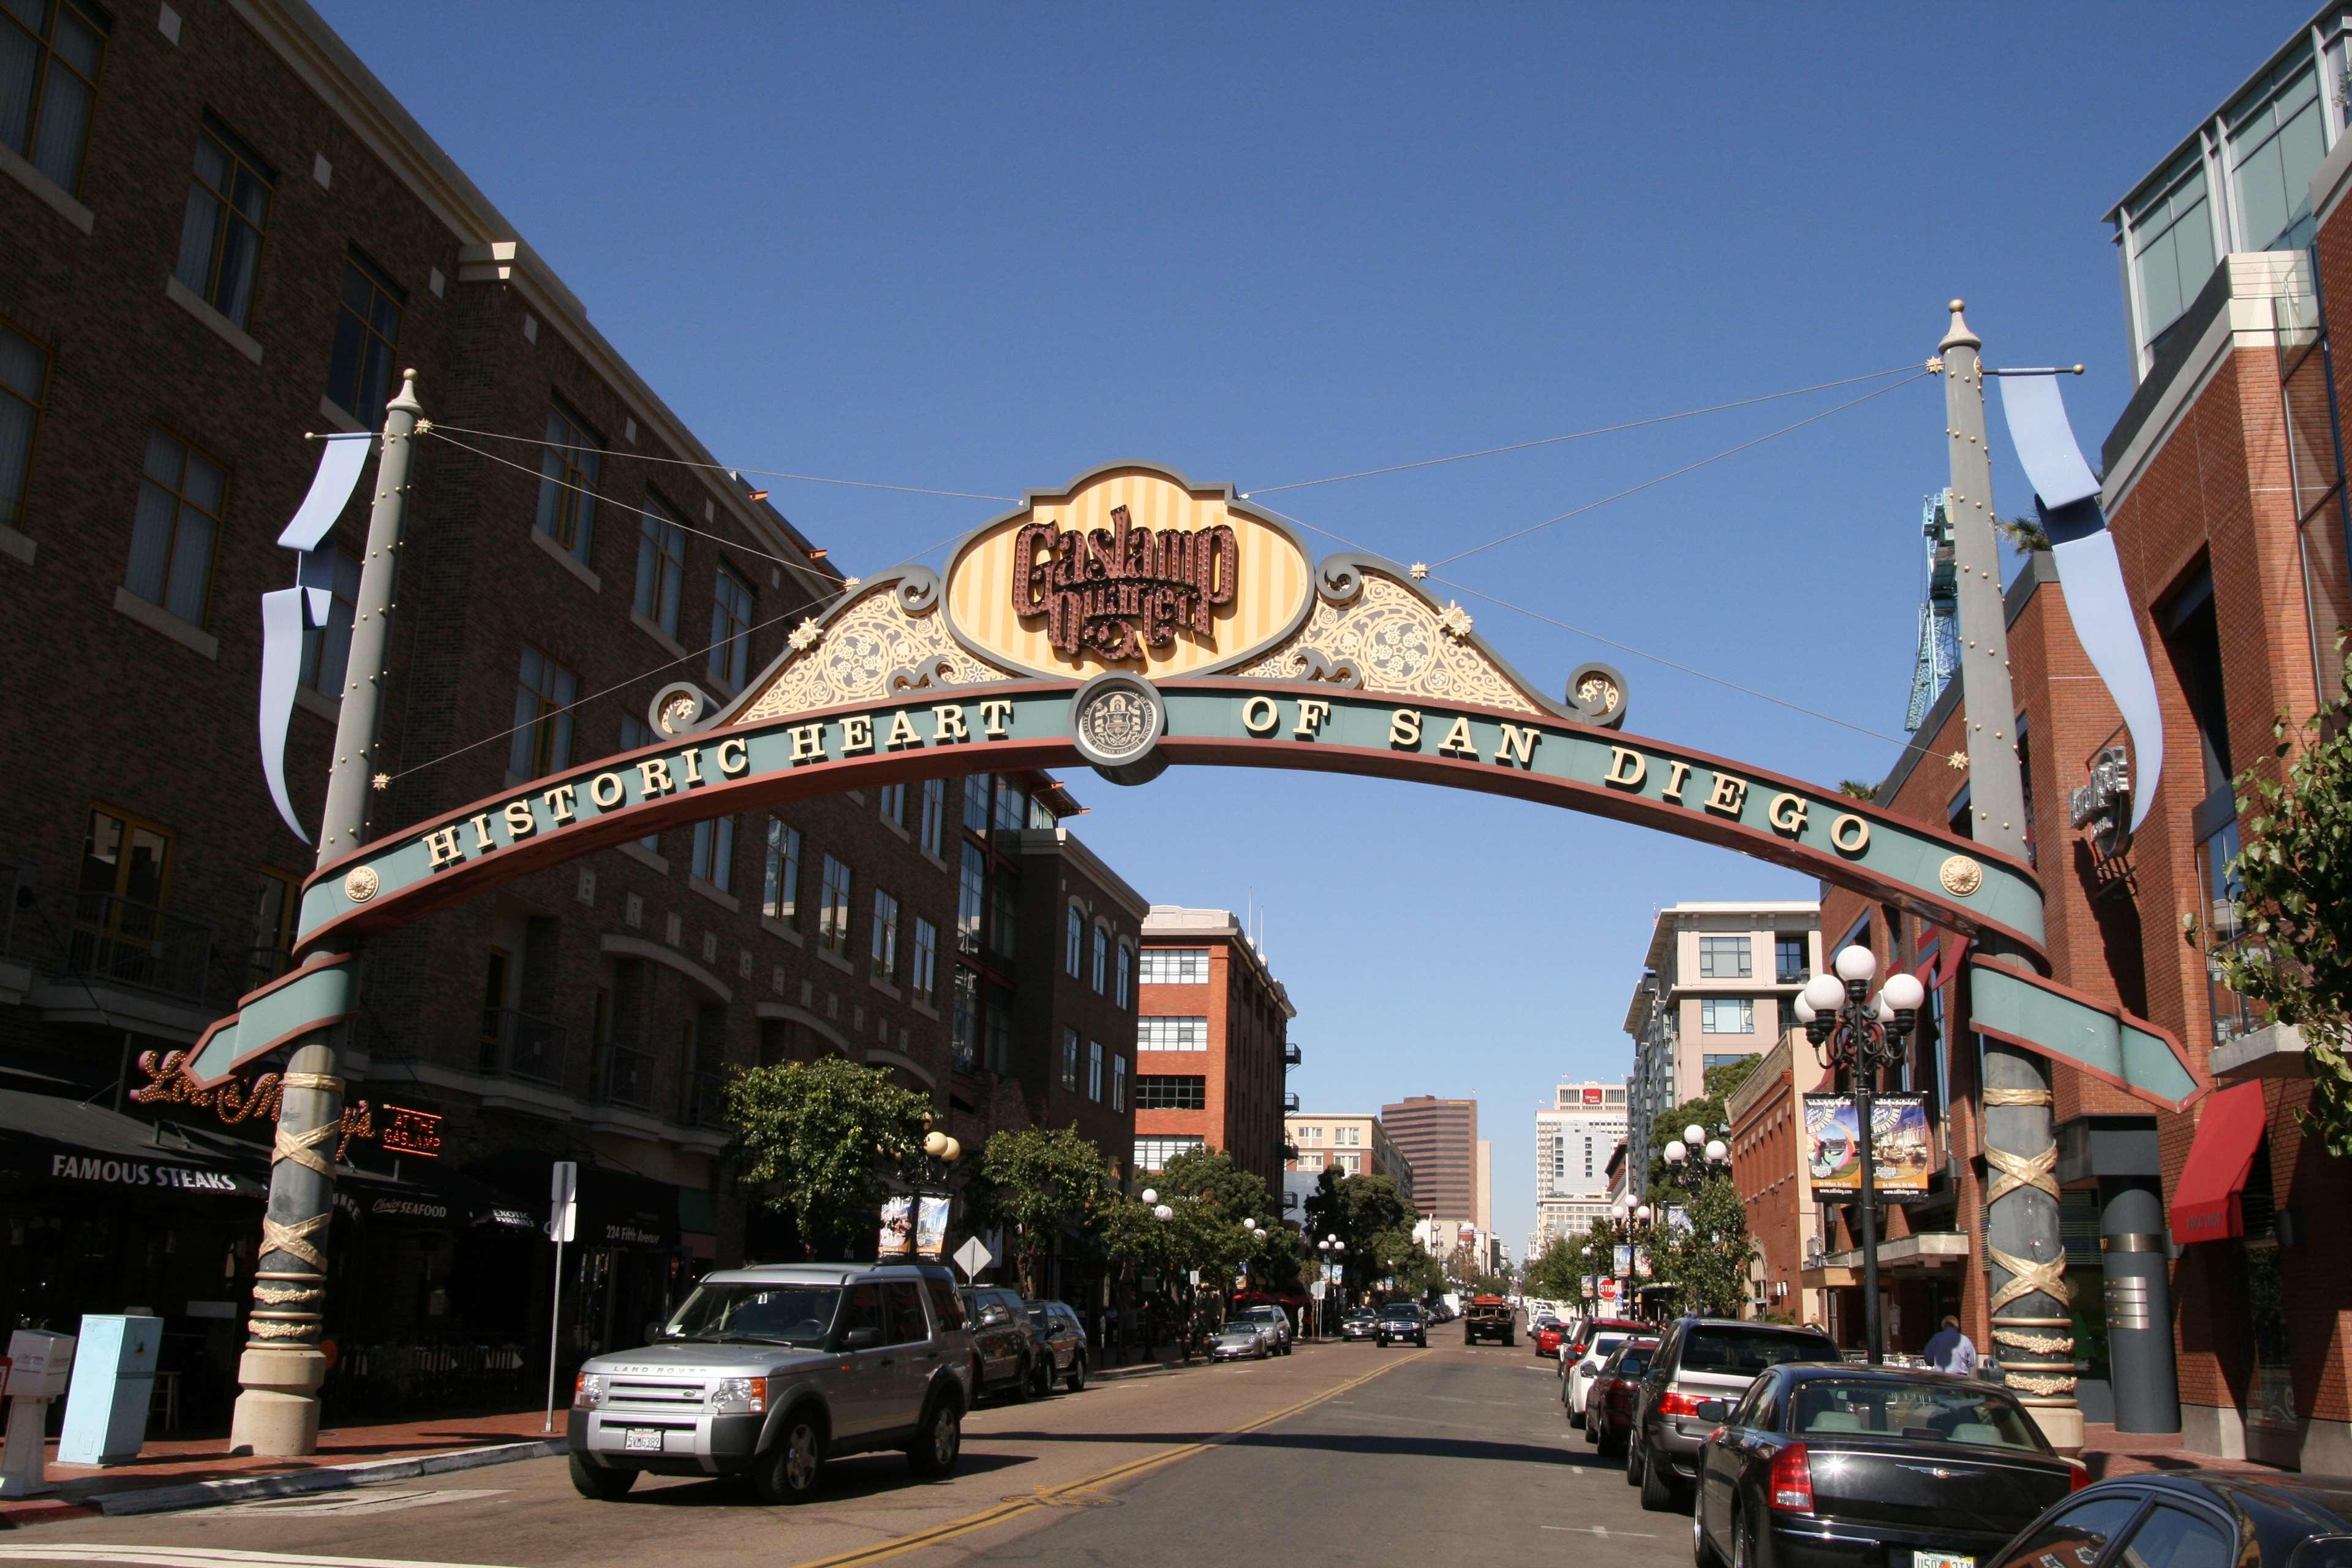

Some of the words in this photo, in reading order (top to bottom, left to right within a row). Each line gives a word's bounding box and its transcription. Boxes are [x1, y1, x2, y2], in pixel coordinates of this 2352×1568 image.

[1012, 505, 1235, 639] Gaslamp
[1048, 579, 1201, 662] Quarter
[422, 737, 748, 867] HISTORIC
[787, 700, 1012, 761] HEART
[1242, 696, 1329, 734] OF
[1389, 709, 1540, 763] SAN
[1604, 745, 1869, 851] DIEGO
[394, 1114, 410, 1128] AT
[414, 1116, 437, 1134] THE
[51, 1154, 151, 1185] FAMOUS
[156, 1166, 236, 1191] STEAKS
[399, 1202, 447, 1218] SEAFOOD
[493, 1209, 530, 1220] EXOTIC
[496, 1216, 534, 1227] DRINKS
